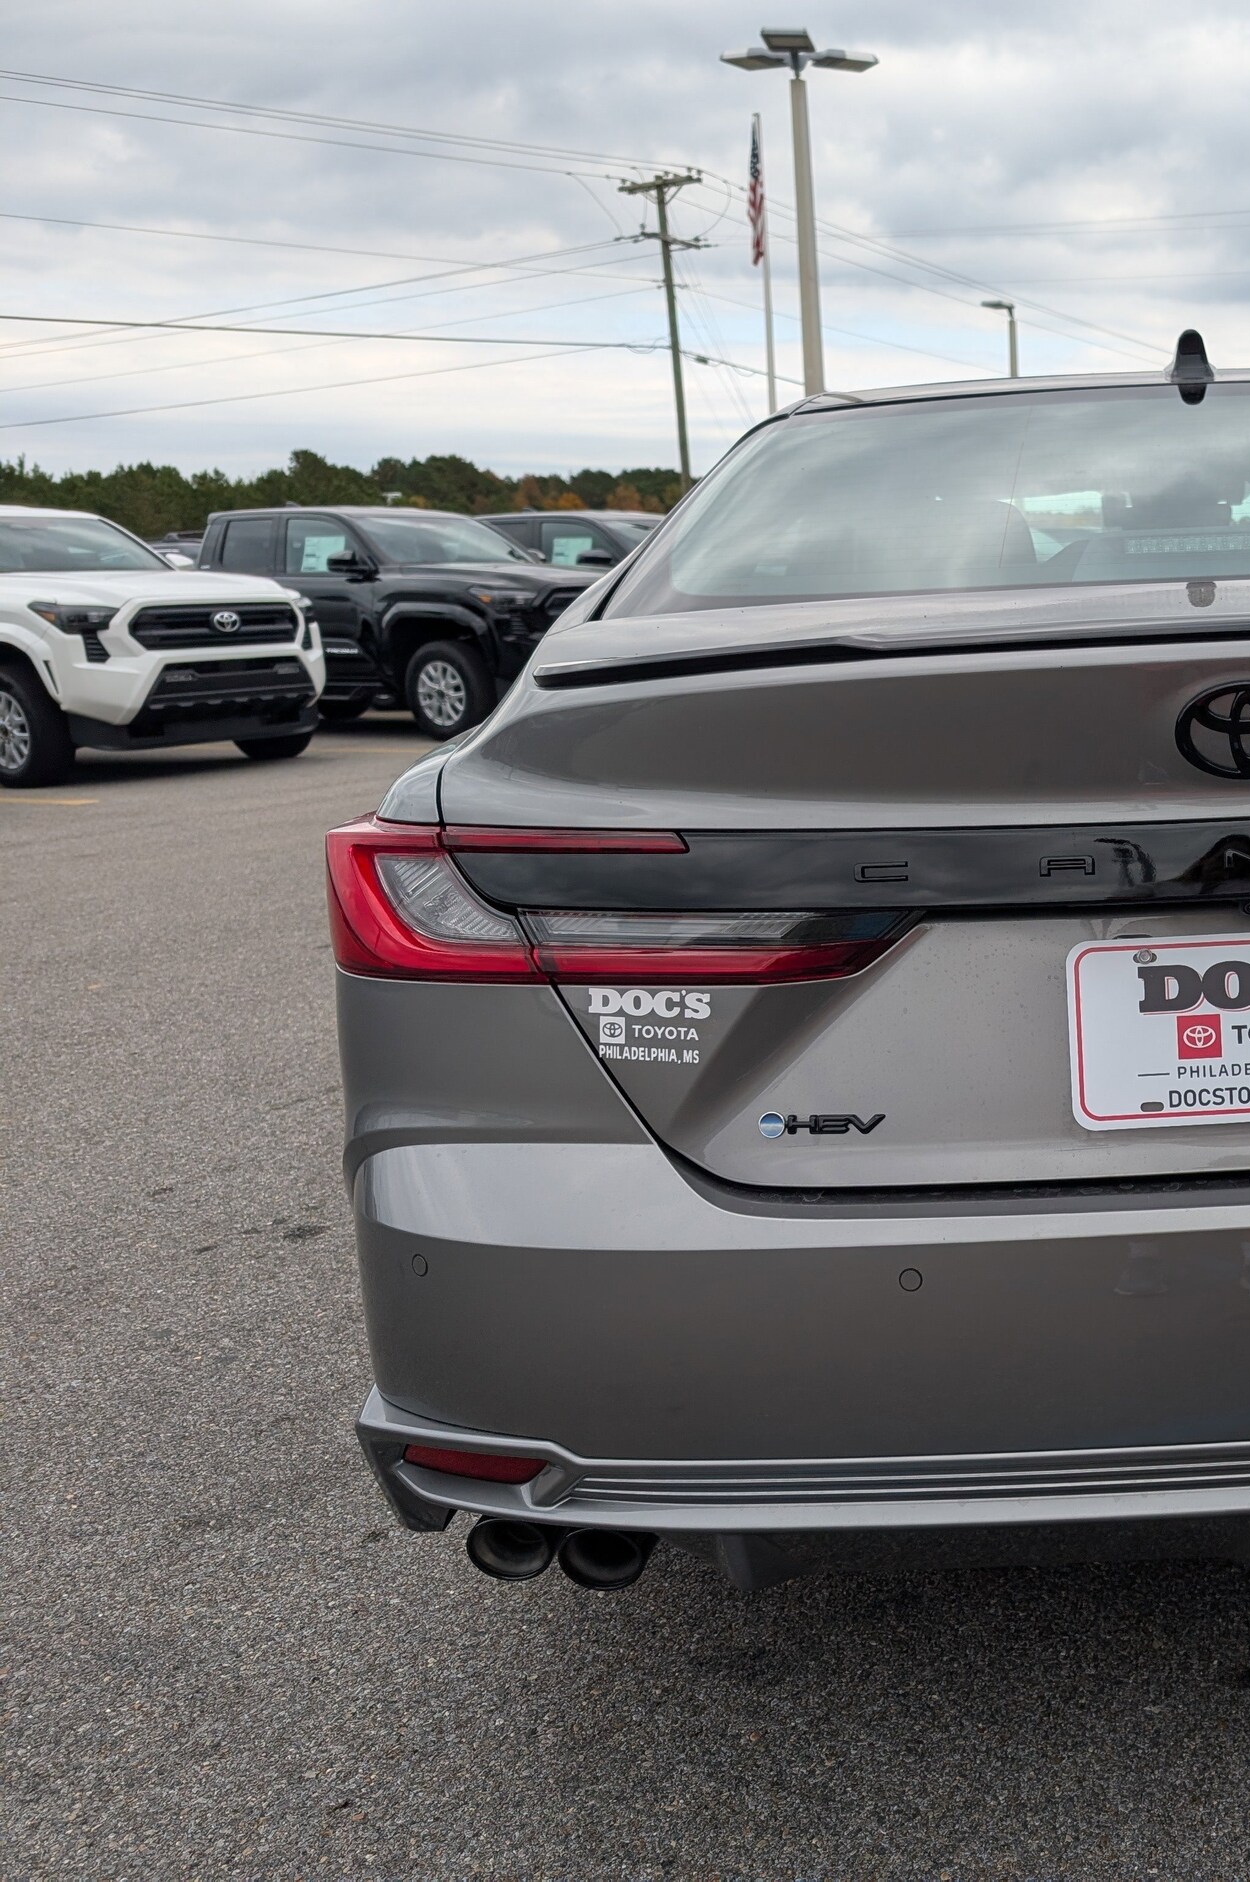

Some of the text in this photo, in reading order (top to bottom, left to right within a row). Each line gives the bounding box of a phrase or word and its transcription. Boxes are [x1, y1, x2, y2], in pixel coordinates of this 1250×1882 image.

[588, 988, 712, 1020] DOC'S
[632, 1024, 700, 1042] TOYOTA
[599, 1045, 700, 1065] PHILADELPHIA, MS
[786, 1113, 887, 1136] HEV
